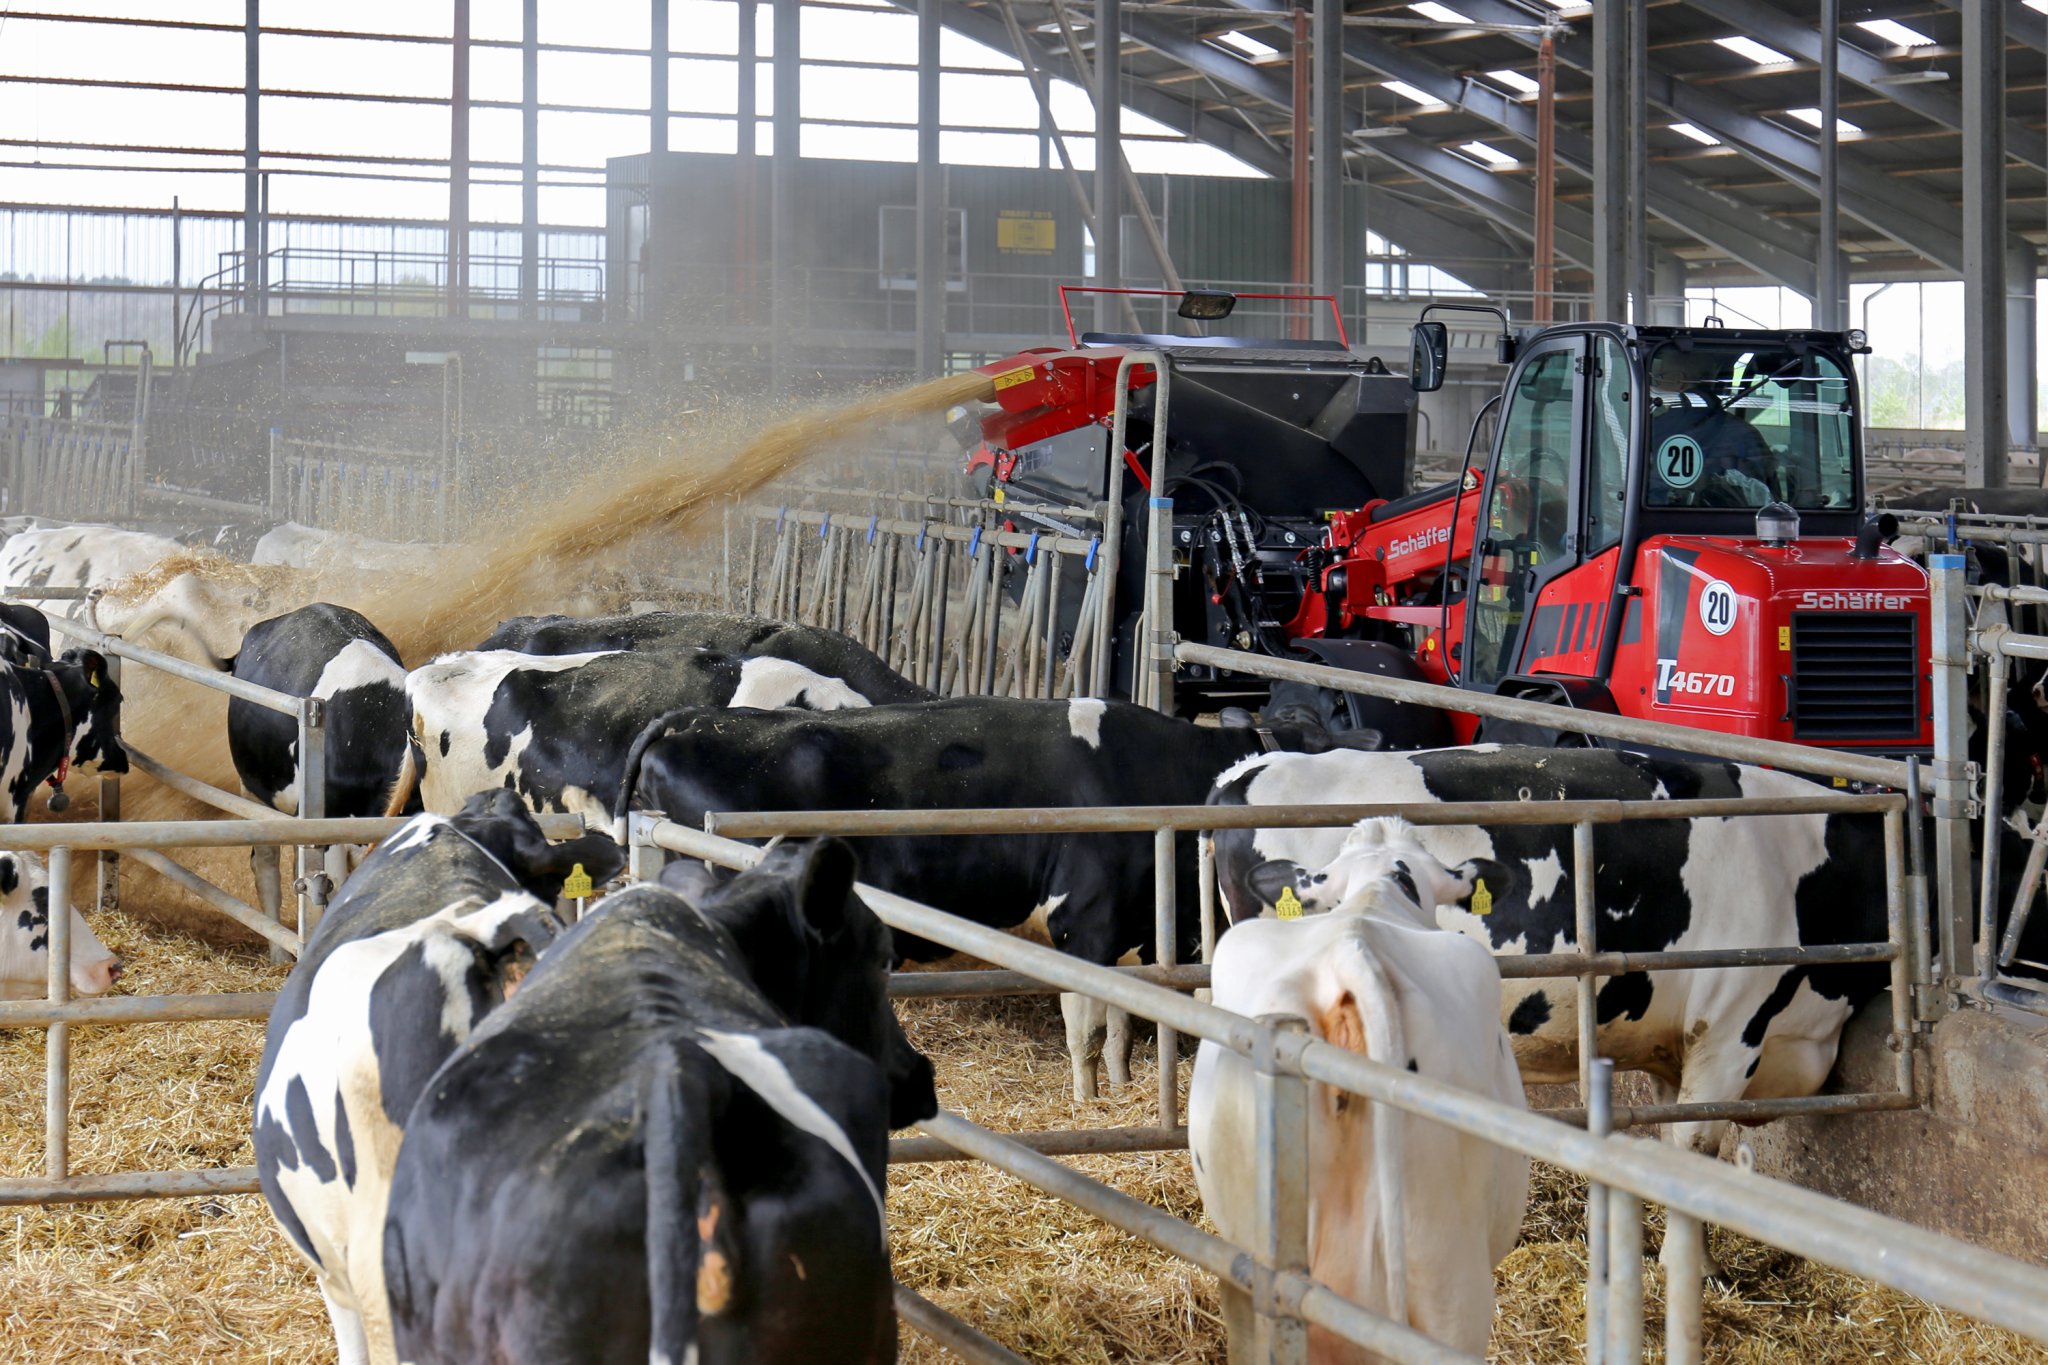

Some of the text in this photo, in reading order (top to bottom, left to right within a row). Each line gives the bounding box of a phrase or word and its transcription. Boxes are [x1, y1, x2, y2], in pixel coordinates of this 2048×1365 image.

[1667, 445, 1694, 478] 20
[1708, 591, 1730, 625] 20
[1796, 592, 1912, 609] Schäffer
[1656, 658, 1735, 697] T4670
